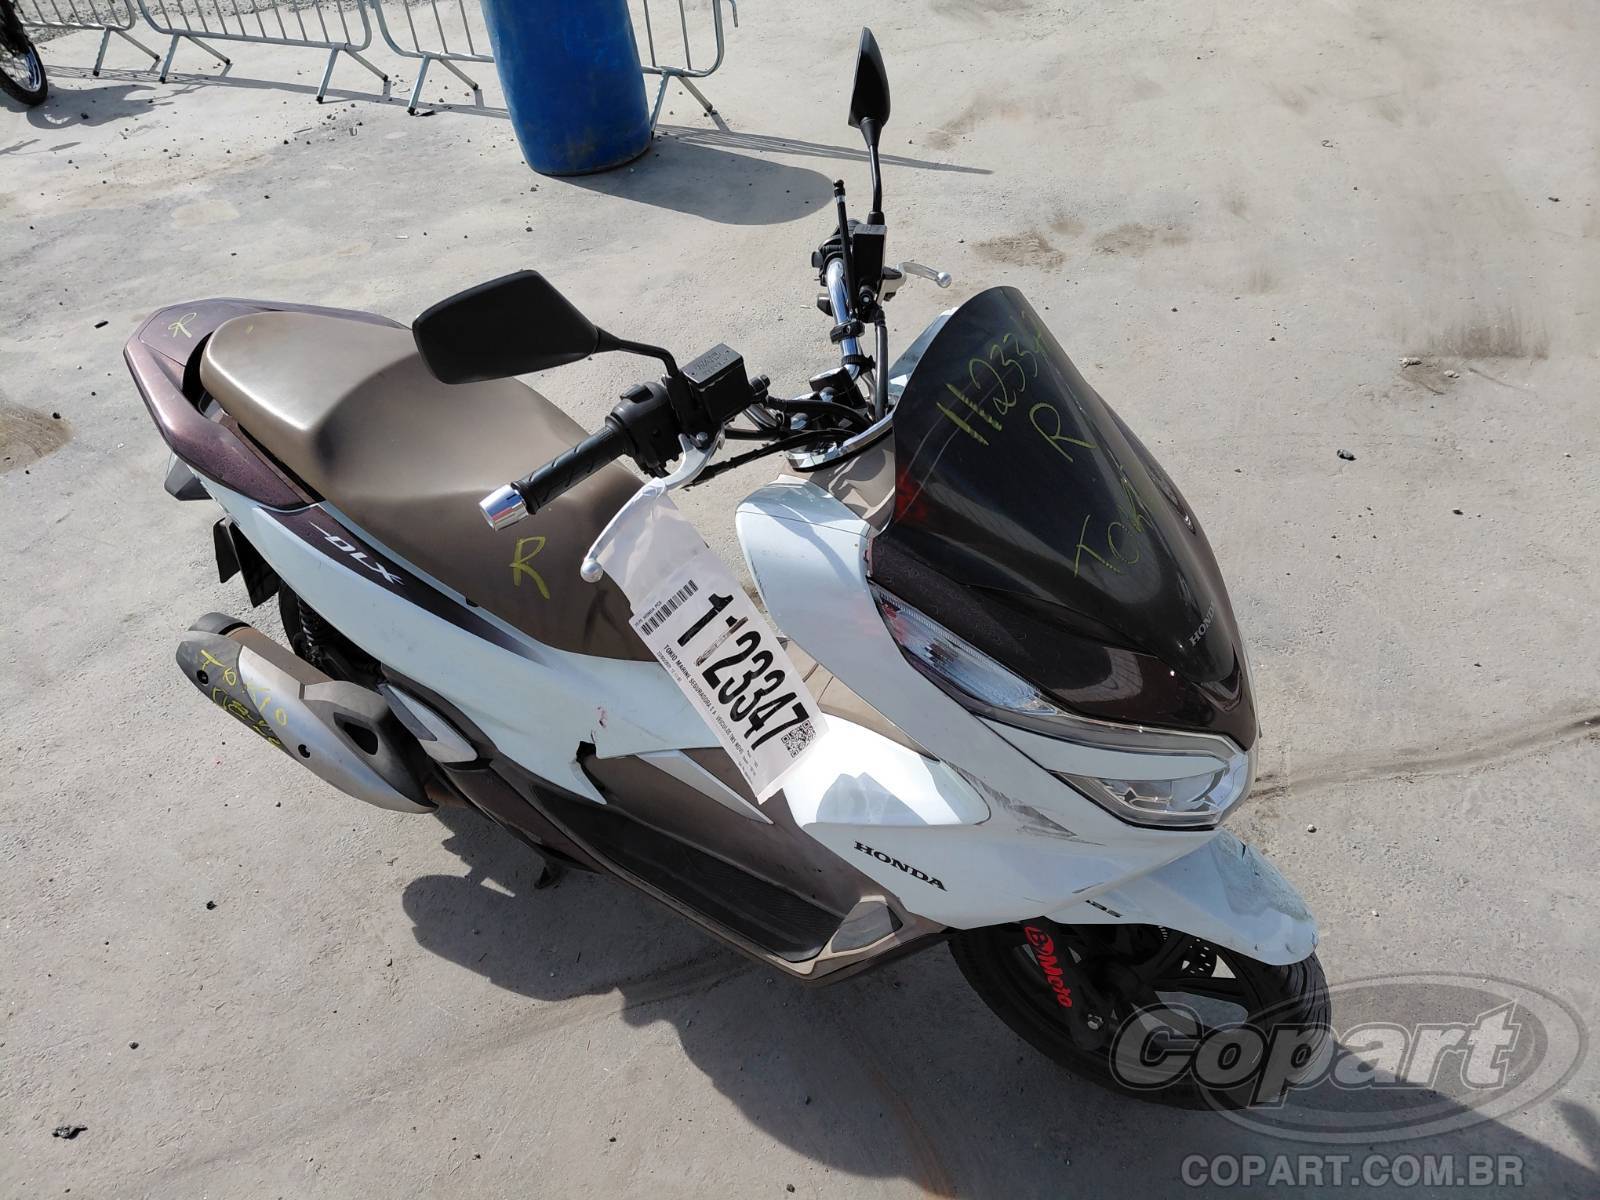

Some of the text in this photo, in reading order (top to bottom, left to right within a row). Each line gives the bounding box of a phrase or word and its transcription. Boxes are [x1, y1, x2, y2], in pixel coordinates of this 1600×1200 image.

[168, 312, 197, 338] R
[1029, 402, 1097, 463] R
[308, 520, 405, 585] DLX
[509, 536, 550, 600] R
[663, 644, 678, 661] TOKIO
[676, 660, 691, 679] MARINE
[688, 678, 712, 709] SEGURADORA
[677, 593, 809, 751] 1123347
[854, 840, 948, 892] HONDA
